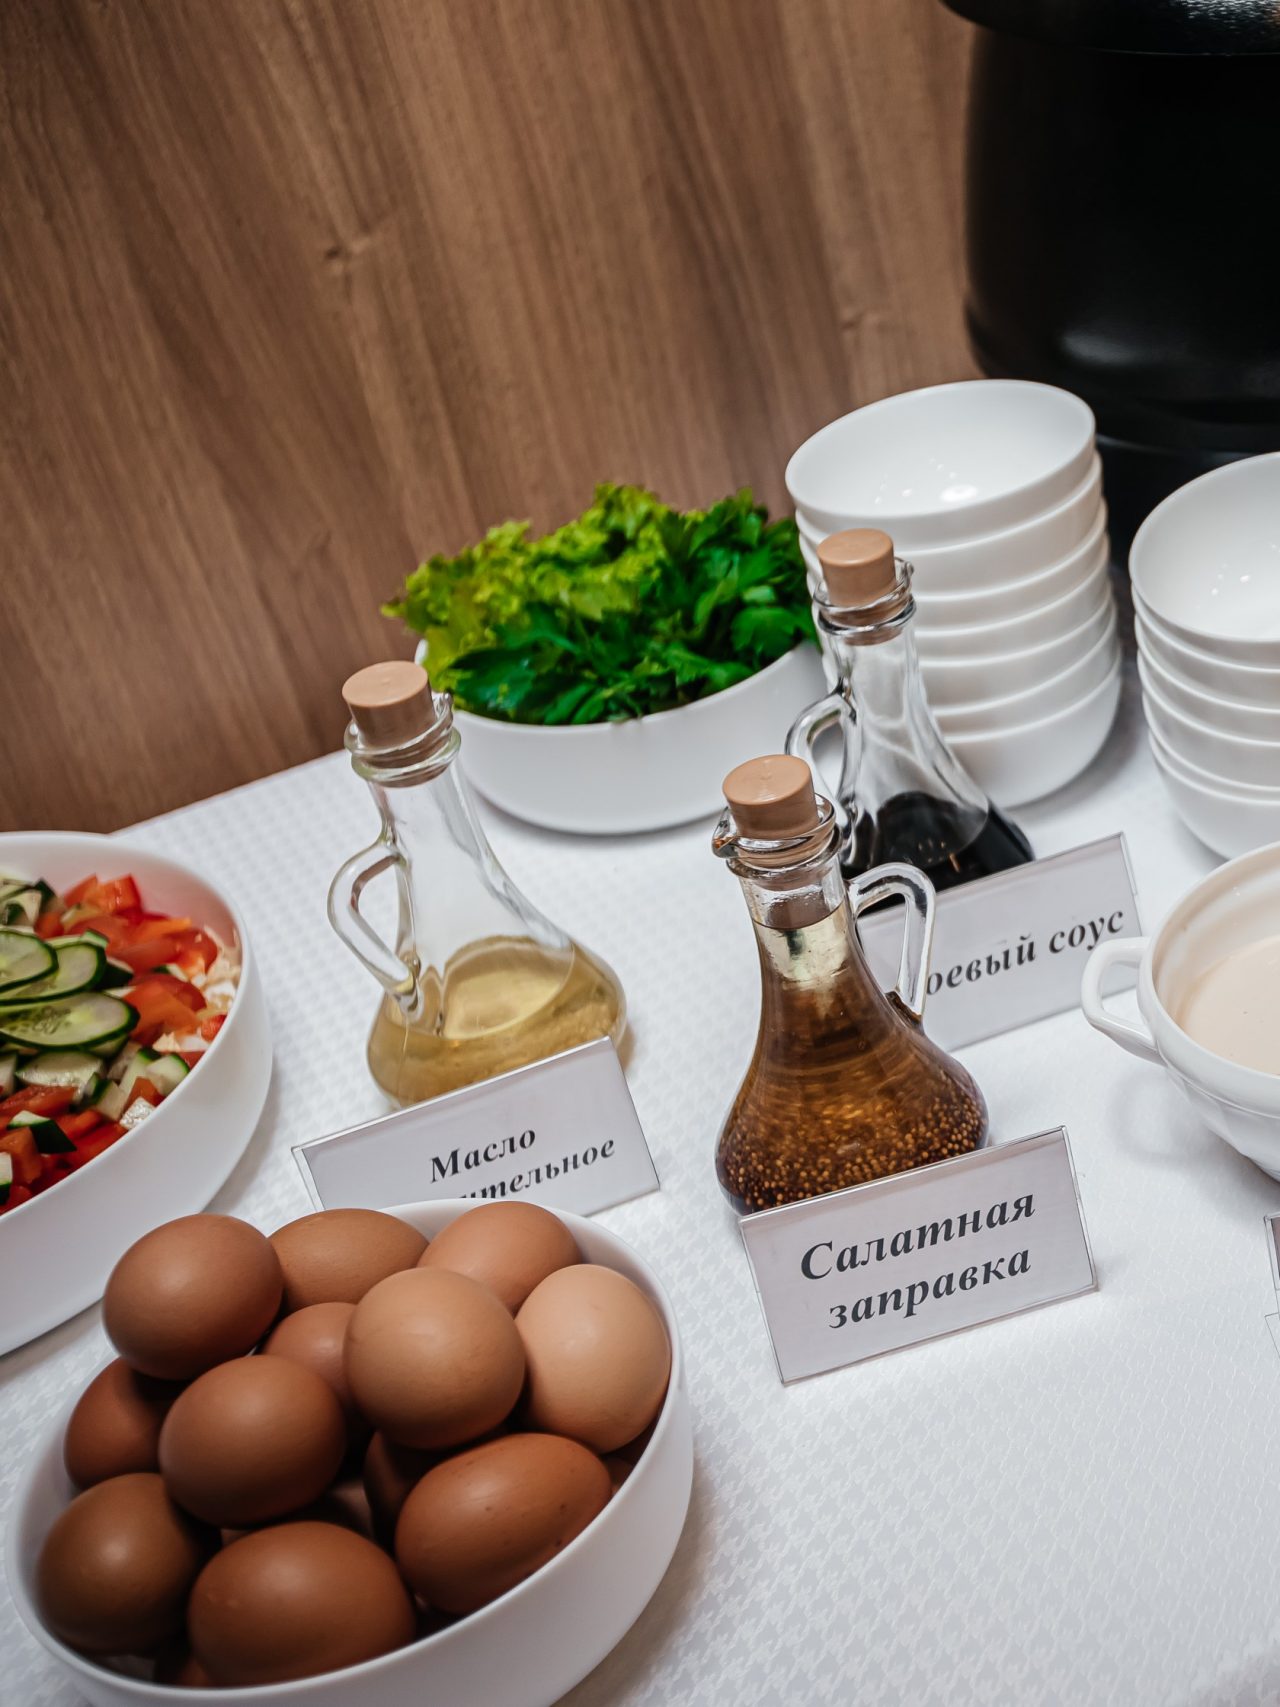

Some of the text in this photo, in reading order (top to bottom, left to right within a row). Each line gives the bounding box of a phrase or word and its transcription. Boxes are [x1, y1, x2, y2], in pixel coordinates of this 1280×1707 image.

[927, 911, 1124, 996] оевый соус
[429, 1129, 536, 1183] Масло
[459, 1139, 616, 1199] тельное
[800, 1194, 1036, 1280] Салатная
[828, 1249, 1032, 1329] заправка
